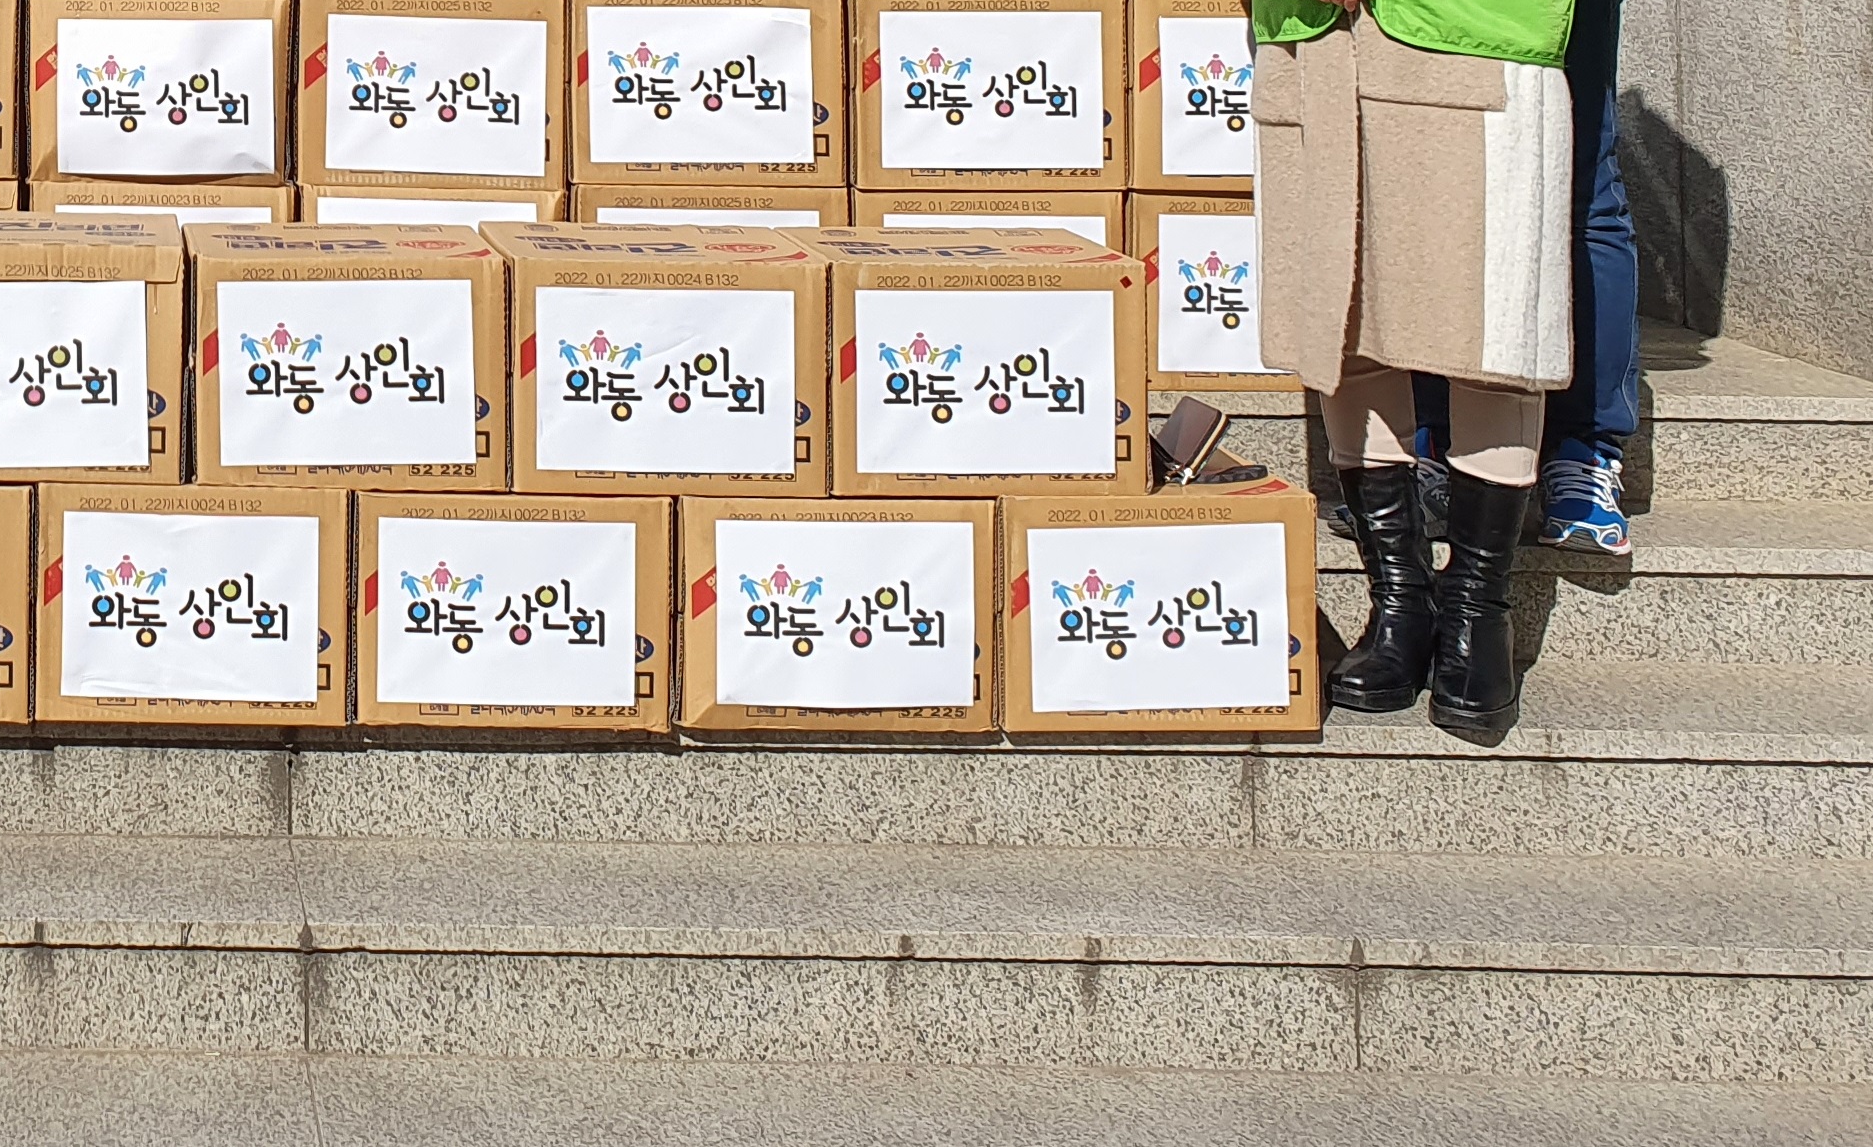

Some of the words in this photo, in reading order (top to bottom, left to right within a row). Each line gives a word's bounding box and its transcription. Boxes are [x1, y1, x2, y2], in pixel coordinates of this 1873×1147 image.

[80, 87, 145, 132] 와동
[157, 69, 248, 125] 상인회
[349, 82, 415, 128] 와동
[427, 68, 519, 125] 상인회
[613, 74, 680, 119] 와동
[691, 55, 786, 111] 상인회
[905, 79, 972, 125] 와동
[983, 61, 1076, 117] 상인회
[1186, 86, 1249, 131] 와동
[1182, 283, 1248, 329] 와동
[10, 340, 117, 406] 상인회
[246, 360, 324, 414] 와동
[336, 337, 444, 404] 상인회
[564, 367, 642, 421] 와동
[654, 348, 764, 414] 상인회
[884, 370, 962, 423] 와동
[975, 348, 1084, 414] 상인회
[89, 593, 167, 647] 와동
[180, 574, 287, 641] 상인회
[405, 599, 483, 653] 와동
[496, 580, 604, 646] 상인회
[745, 602, 823, 656] 와동
[836, 581, 944, 647] 상인회
[1058, 607, 1136, 659] 와동
[1149, 581, 1257, 648] 상인회
